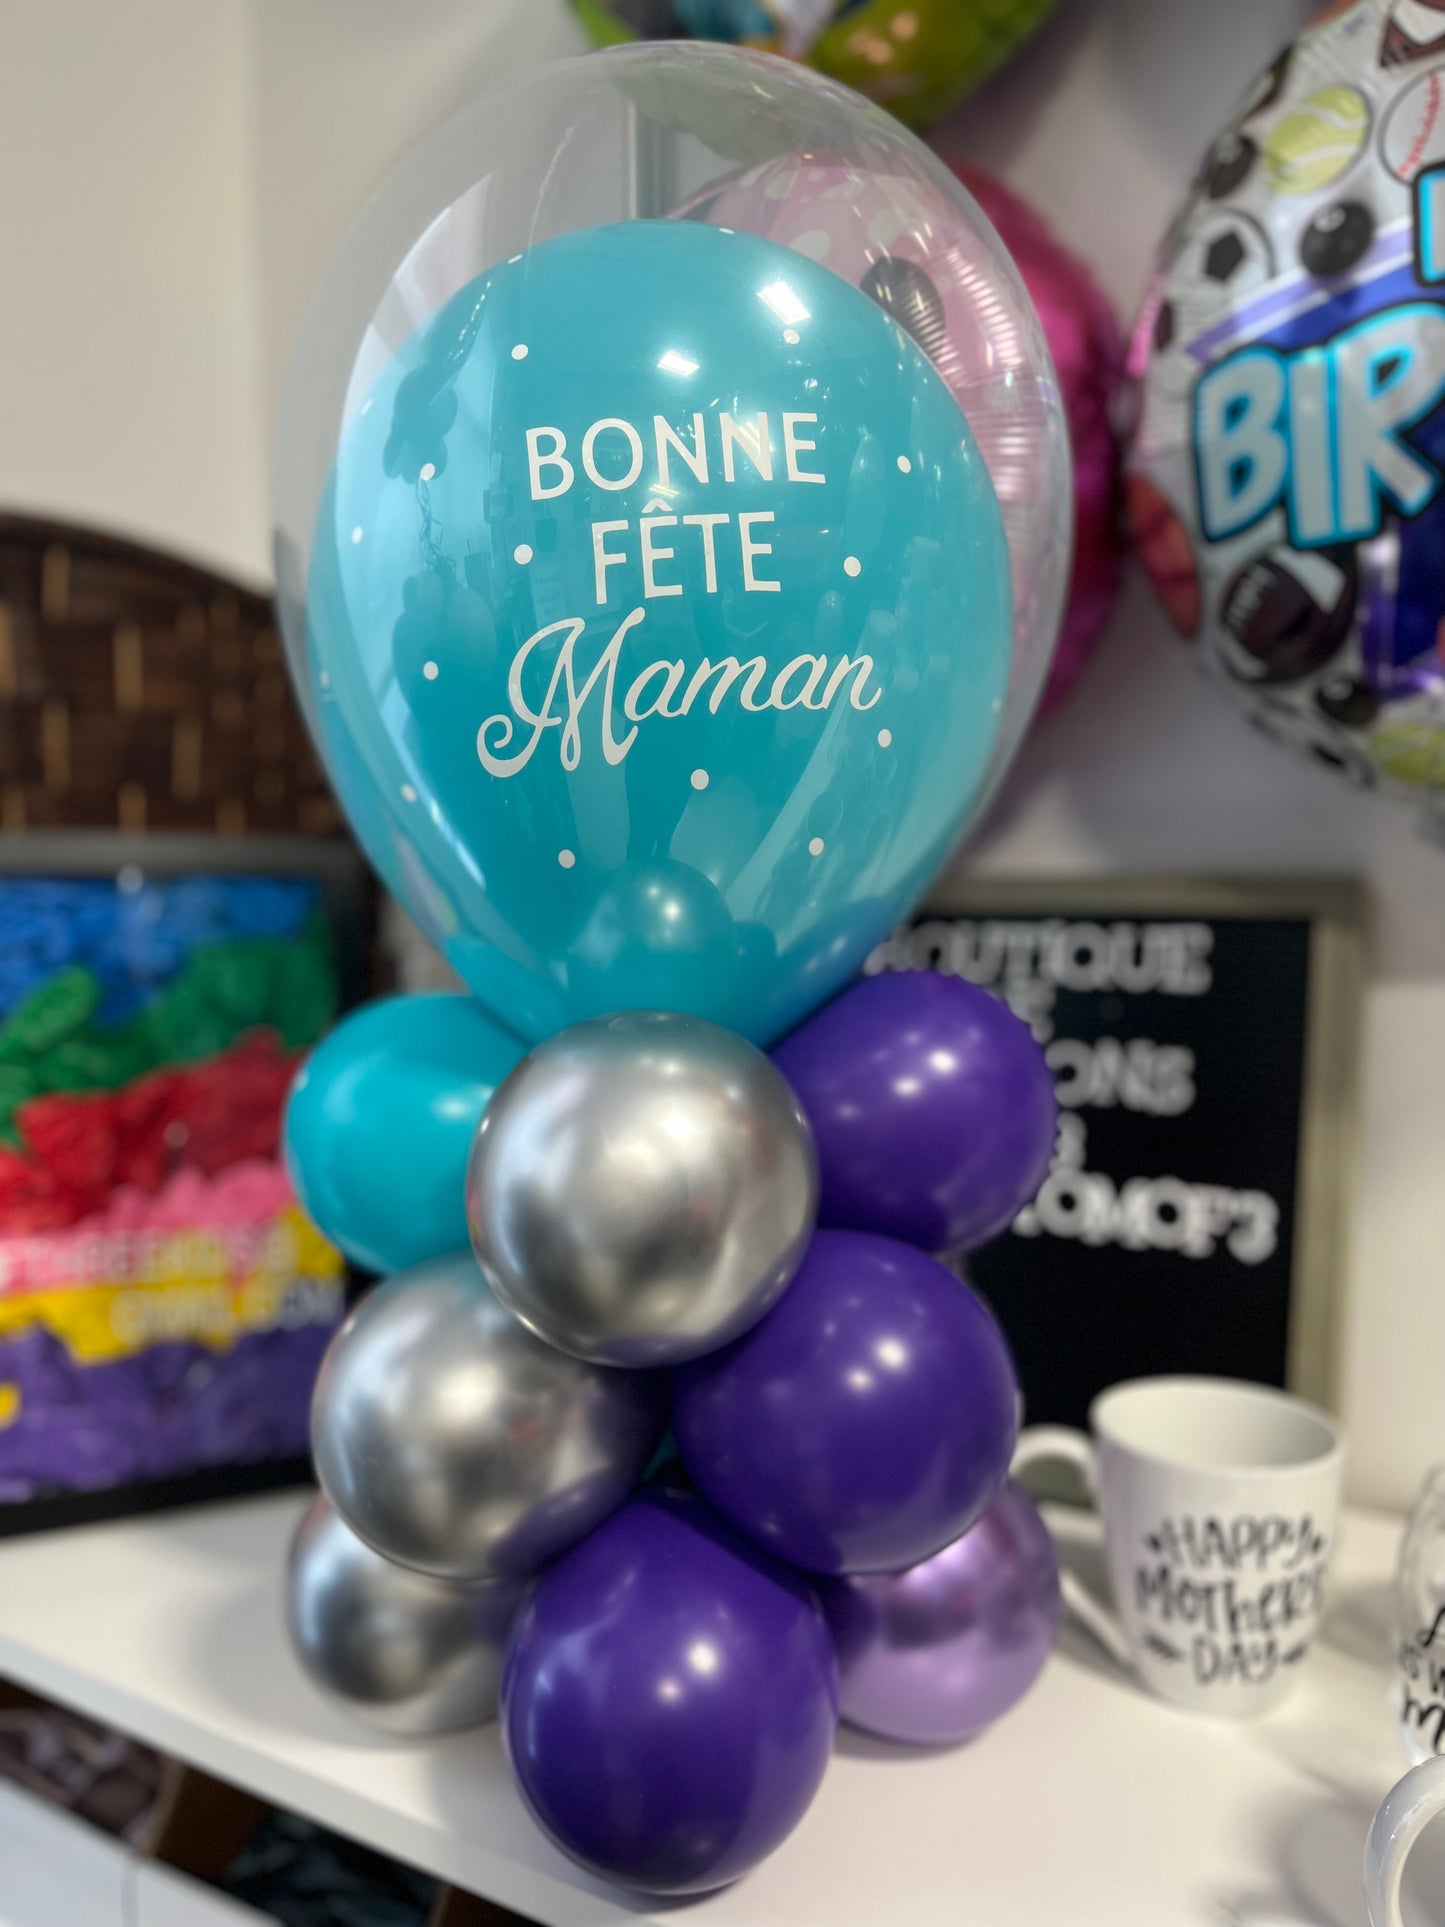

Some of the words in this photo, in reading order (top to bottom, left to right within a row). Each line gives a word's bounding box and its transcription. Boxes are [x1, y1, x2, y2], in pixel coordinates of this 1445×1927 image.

[525, 411, 826, 500] BONNE
[591, 498, 781, 604] FÊTE
[476, 606, 882, 778] Maman
[865, 920, 1214, 995] OUTIQUE
